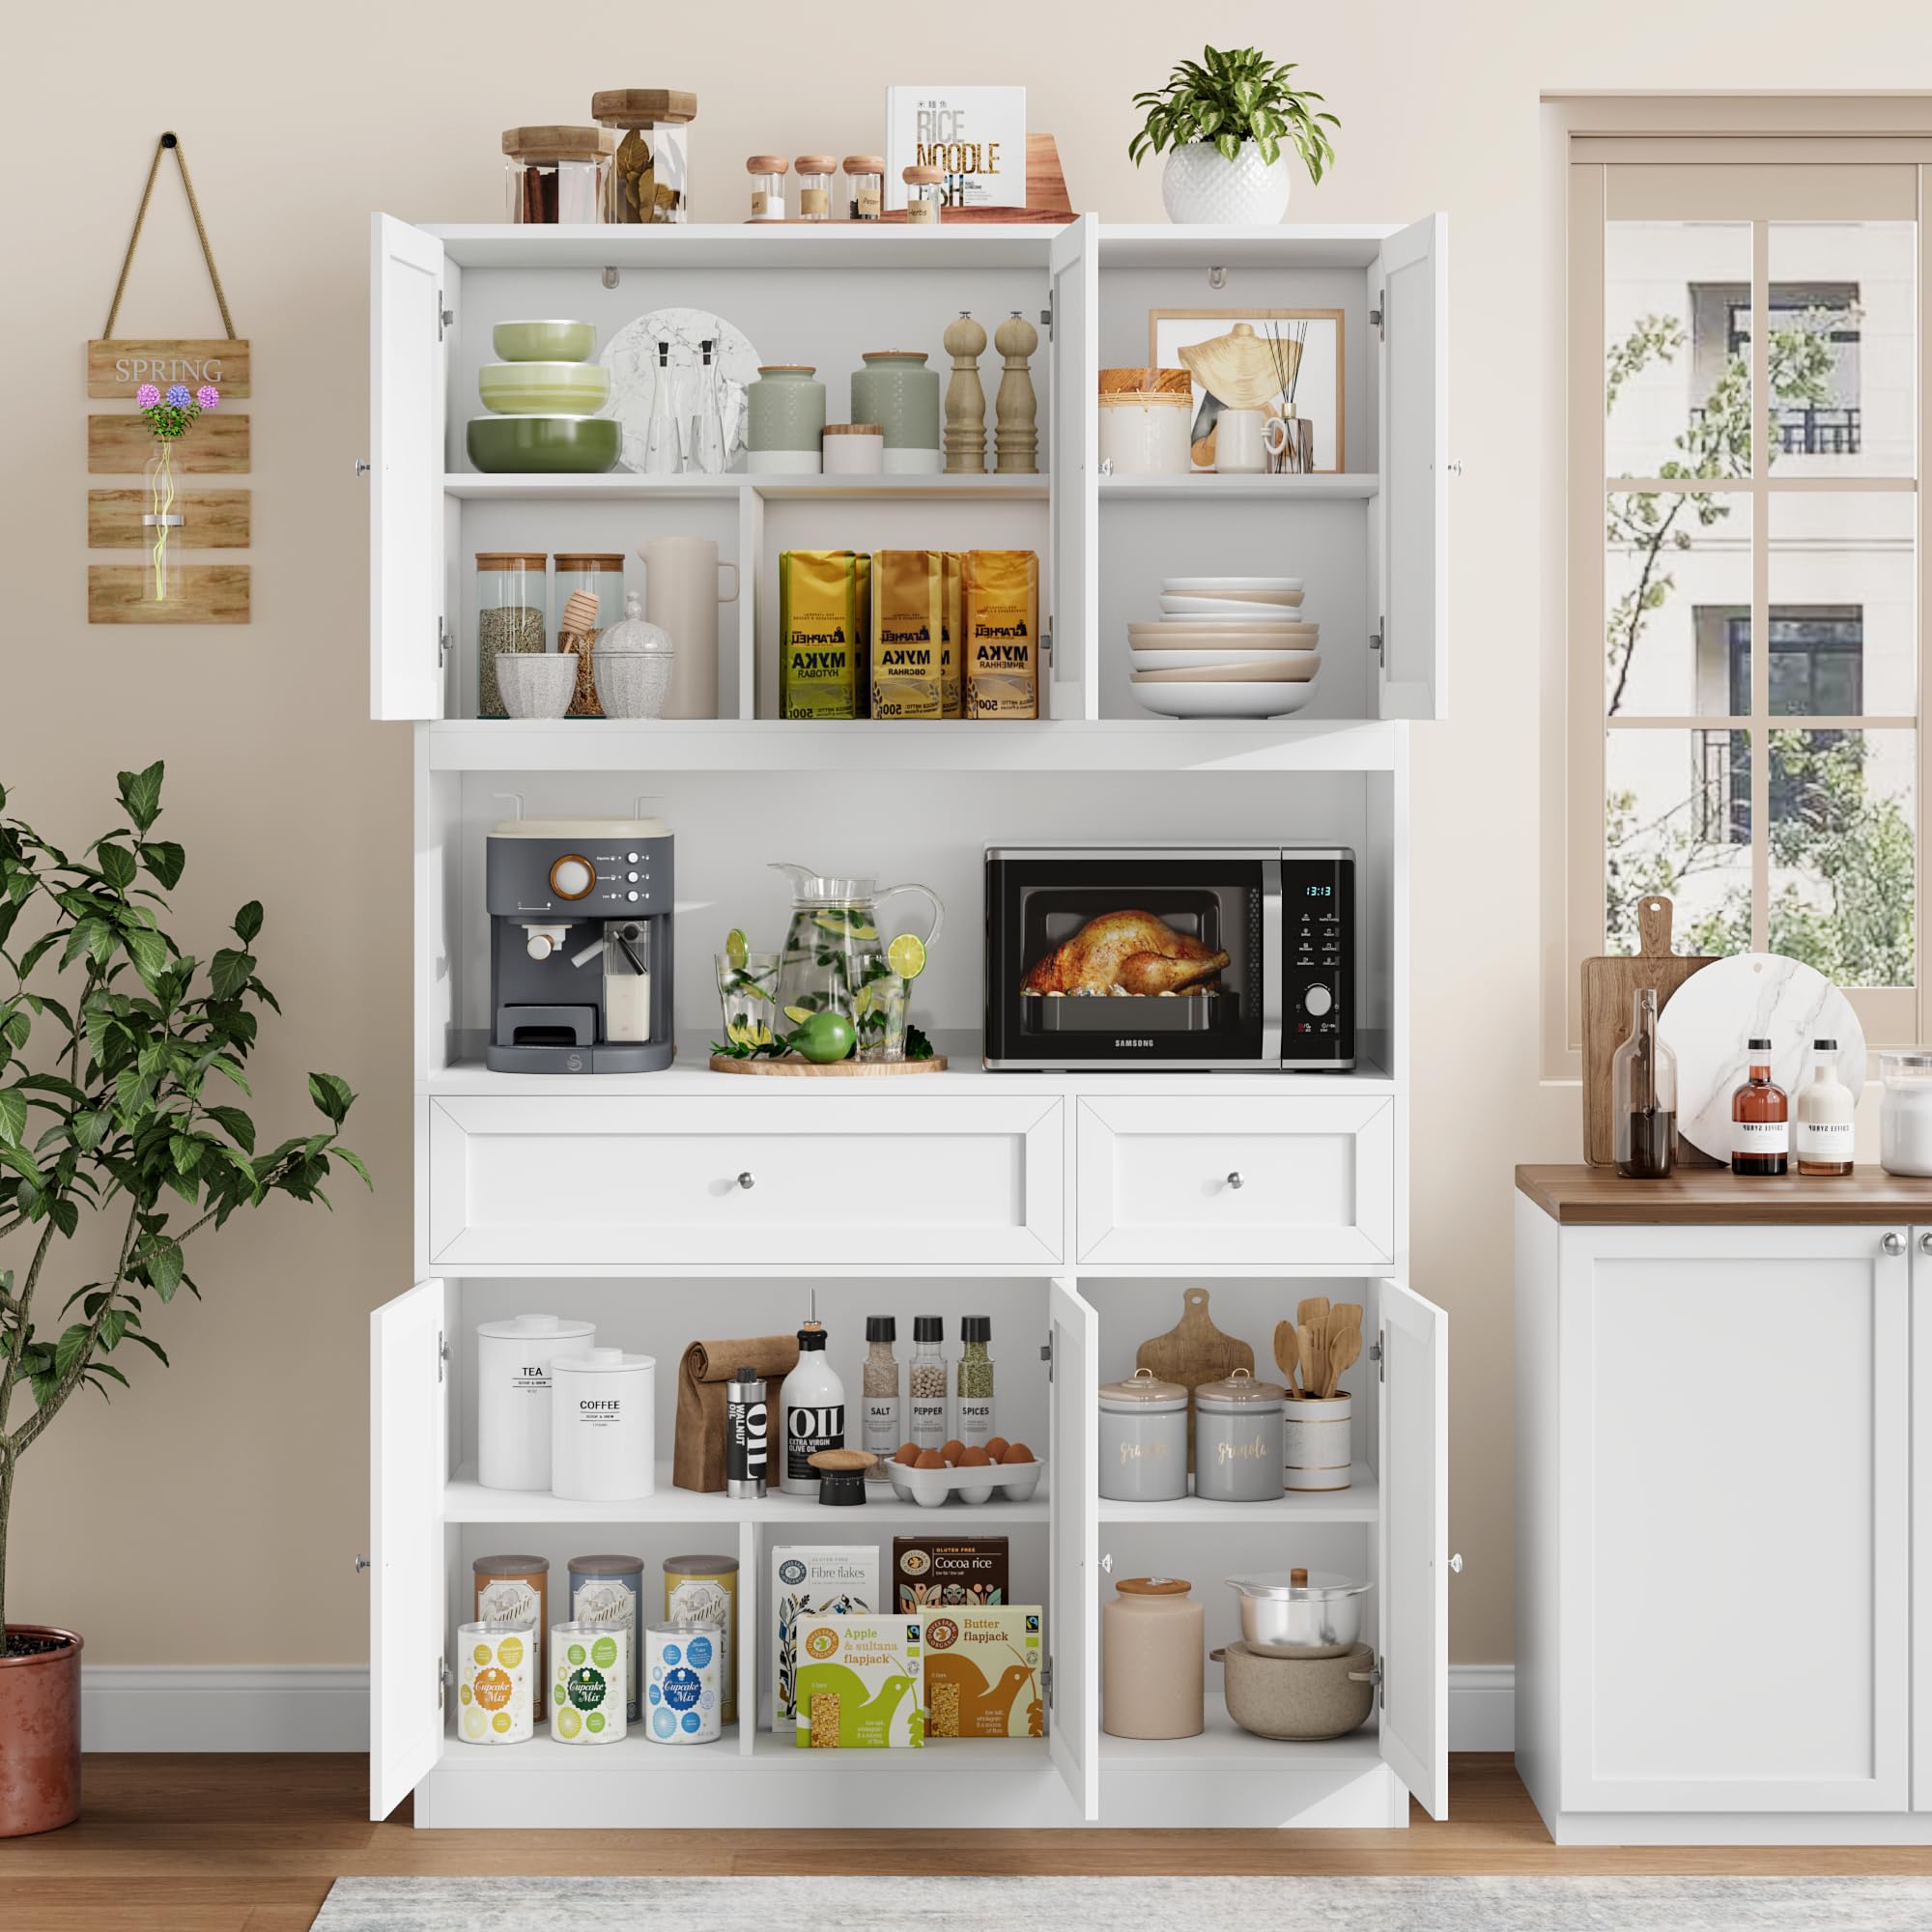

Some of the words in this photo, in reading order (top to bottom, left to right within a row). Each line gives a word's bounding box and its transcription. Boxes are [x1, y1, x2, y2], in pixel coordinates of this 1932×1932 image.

[917, 110, 965, 143] RICE
[917, 143, 1000, 174] NOODLE
[115, 358, 223, 384] SPRING
[1306, 886, 1331, 896] 13:13
[522, 1367, 543, 1376] TEA
[580, 1400, 620, 1409] COFFEE
[870, 1406, 891, 1415] SALT
[914, 1406, 943, 1415] PEPPER
[962, 1406, 989, 1415] SPICES
[735, 1405, 745, 1446] WALNUT
[789, 1407, 844, 1438] OIL
[747, 1404, 767, 1479] OIL
[935, 1556, 970, 1569] Cocoa
[972, 1556, 992, 1569] rice
[811, 1566, 835, 1578] Fibre
[838, 1566, 866, 1578] flakes
[963, 1618, 1000, 1629] Butter
[843, 1628, 878, 1640] Apple
[963, 1632, 1009, 1643] flapjack
[843, 1641, 852, 1651] &
[856, 1641, 897, 1651] sultana
[930, 1634, 956, 1649] ORGANIC
[843, 1654, 890, 1665] flapjack
[475, 1681, 510, 1693] Cupcake
[569, 1681, 604, 1693] Cupcake
[665, 1681, 699, 1693] Cupcake
[486, 1691, 506, 1702] Mix
[578, 1691, 601, 1702] Mix
[673, 1691, 696, 1702] Mix
